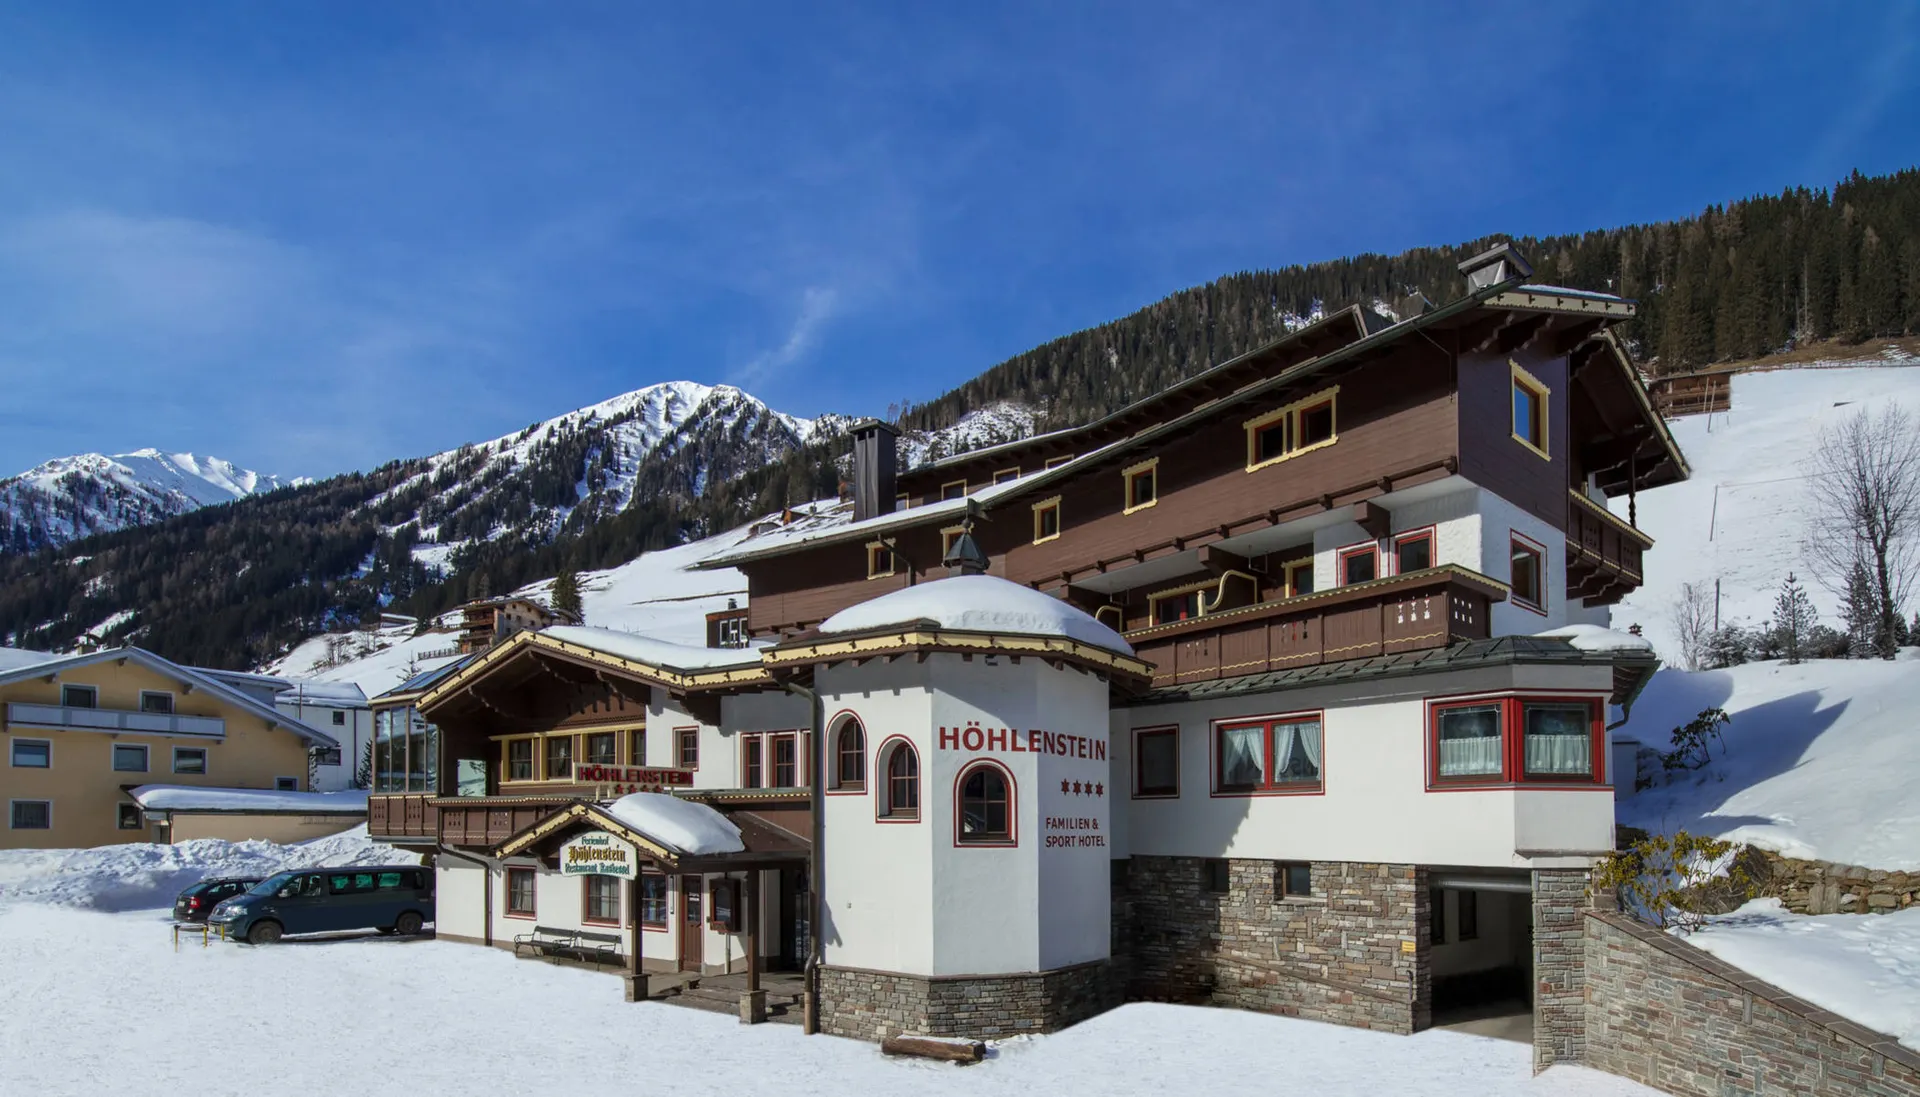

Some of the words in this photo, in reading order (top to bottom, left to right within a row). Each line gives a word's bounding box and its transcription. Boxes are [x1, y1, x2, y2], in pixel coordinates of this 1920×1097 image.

[939, 721, 1106, 761] HÖHLENSTEIN
[580, 764, 694, 785] HÖHLENSTEIN
[1045, 817, 1090, 830] FAMILIEN
[1092, 818, 1099, 830] &
[581, 835, 609, 845] Ferienhof
[1045, 835, 1076, 848] SPORT
[1078, 835, 1106, 848] HOTEL
[568, 844, 626, 863] Höhlenstein
[564, 862, 598, 874] Restaurant
